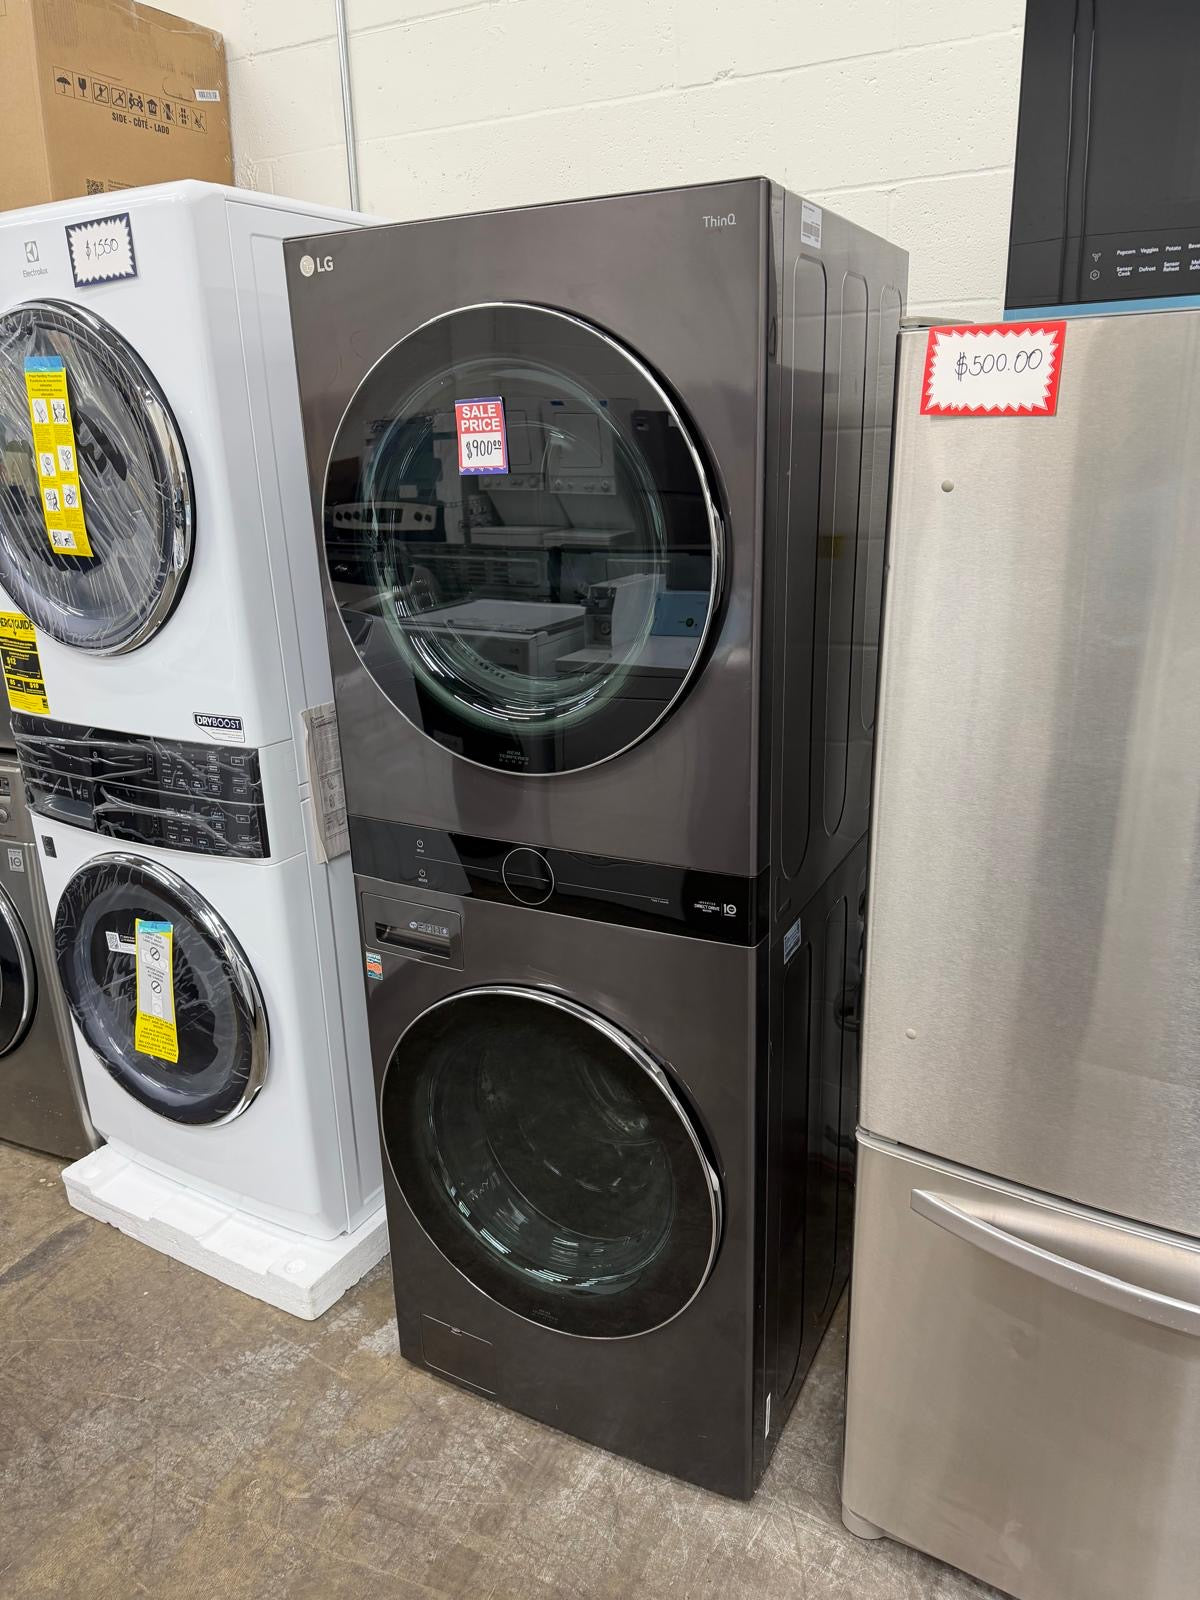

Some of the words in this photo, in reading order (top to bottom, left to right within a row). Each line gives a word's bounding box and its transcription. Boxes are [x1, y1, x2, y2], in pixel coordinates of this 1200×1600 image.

[112, 112, 127, 124] SIDE
[154, 123, 170, 135] LADO
[702, 213, 736, 228] ThinQ
[316, 256, 334, 273] LG
[22, 267, 48, 278] Electrolux
[955, 348, 1043, 382] $500.00
[462, 404, 496, 418] SALE
[461, 418, 501, 432] PRICE
[196, 715, 240, 729] DRYBOOST
